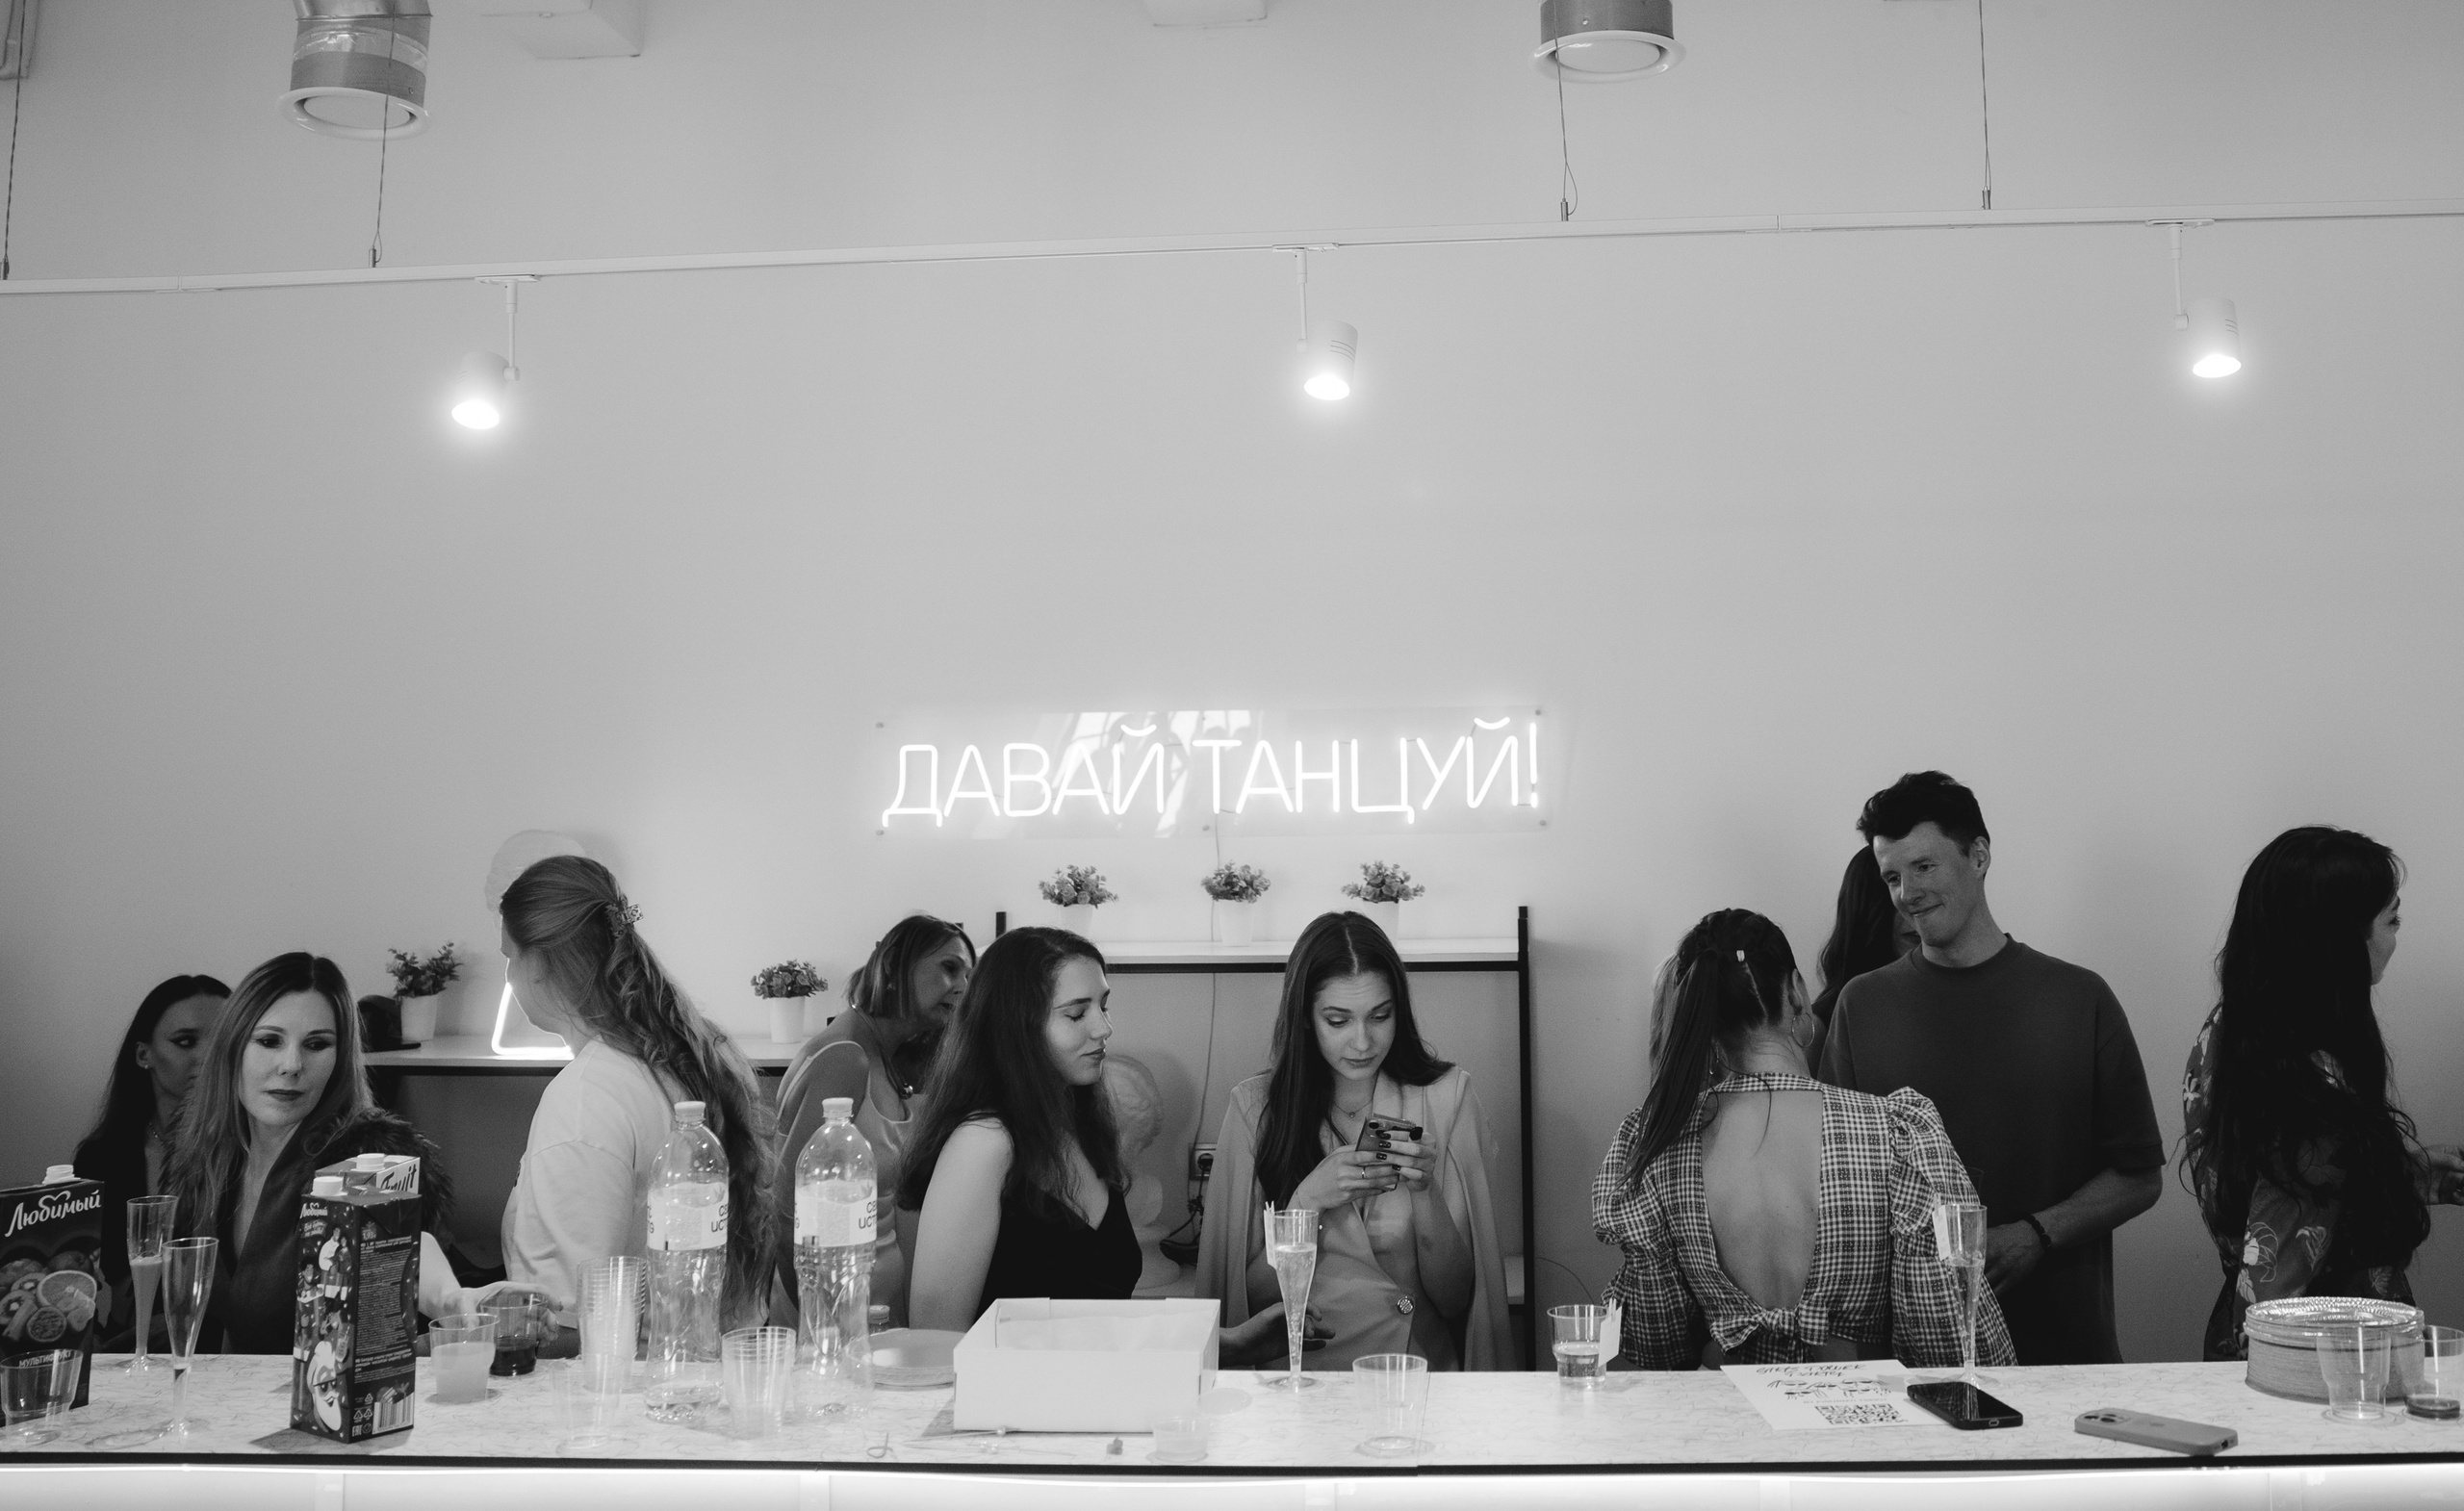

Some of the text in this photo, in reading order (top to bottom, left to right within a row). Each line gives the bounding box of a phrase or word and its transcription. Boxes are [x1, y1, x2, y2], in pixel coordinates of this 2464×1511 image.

[882, 717, 1540, 827] ДАВАЙ ТАНЦУЙ!
[4, 1190, 102, 1238] Любимый
[19, 1349, 72, 1367] МУЛЬТИФУКТ
